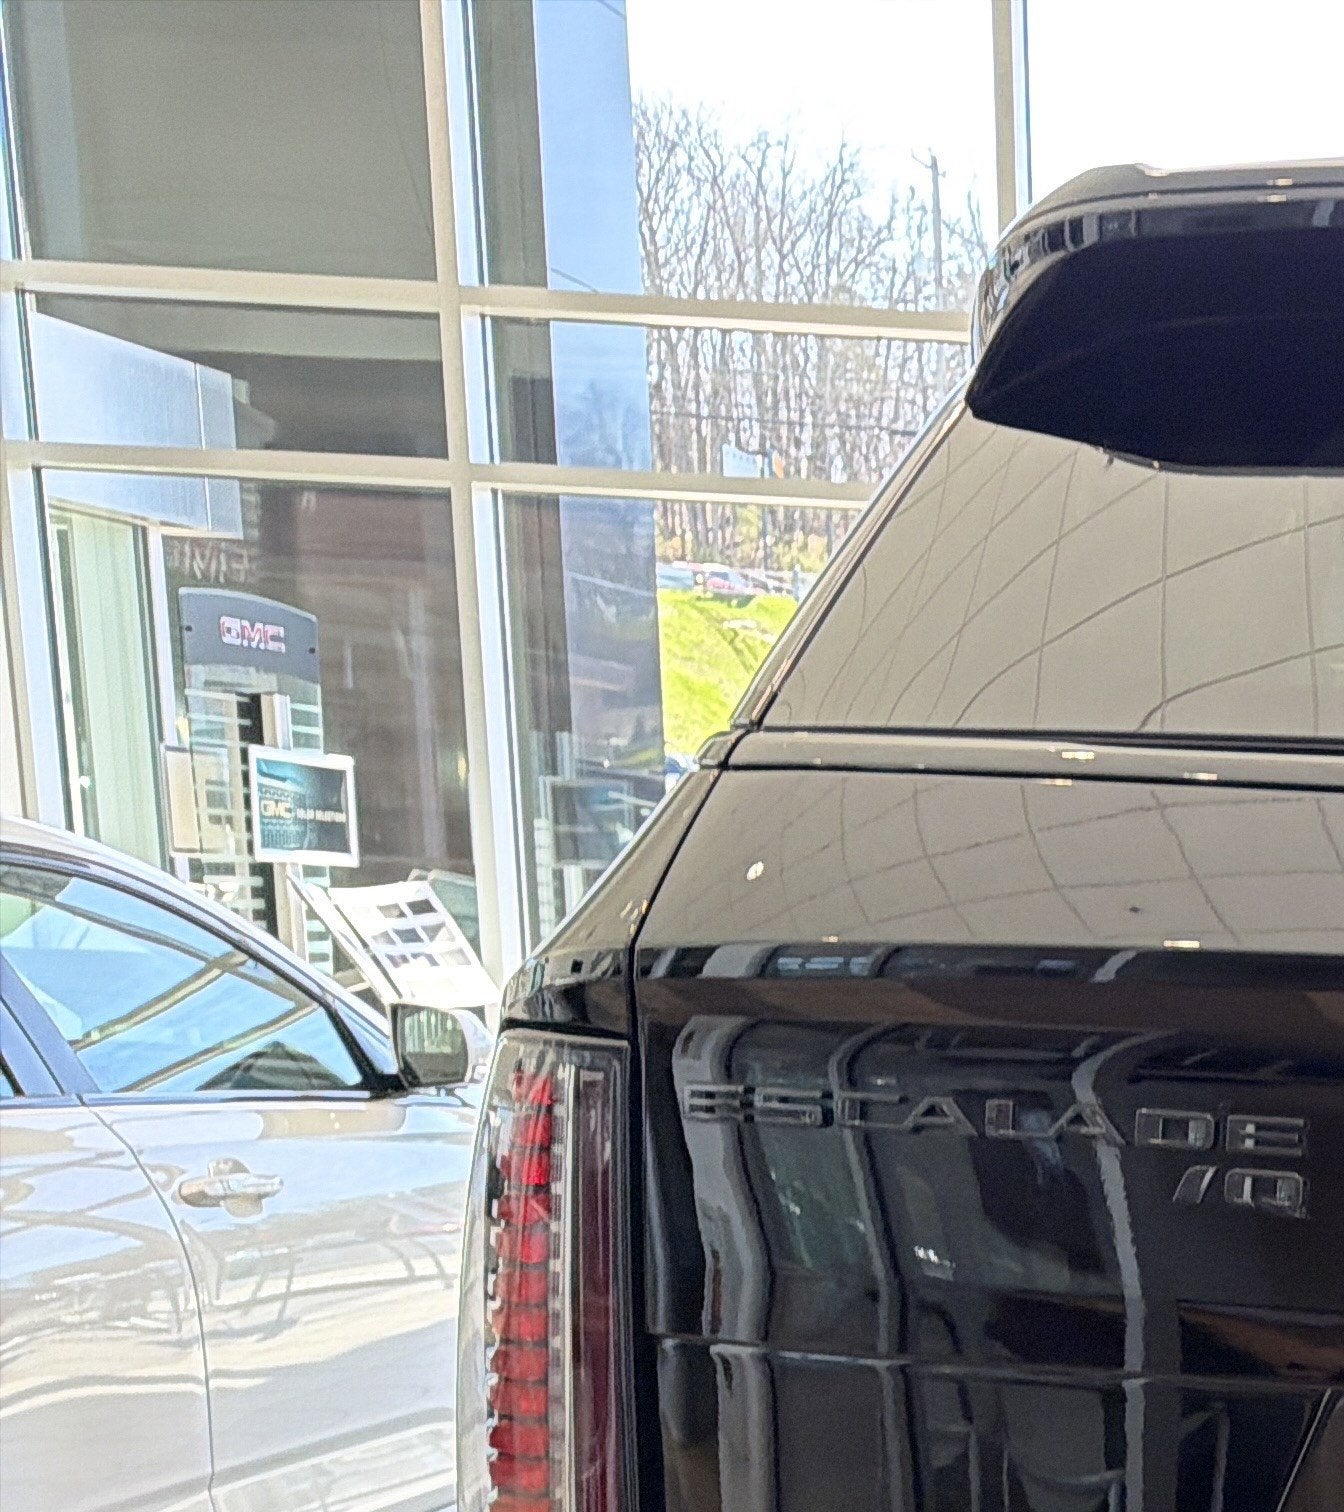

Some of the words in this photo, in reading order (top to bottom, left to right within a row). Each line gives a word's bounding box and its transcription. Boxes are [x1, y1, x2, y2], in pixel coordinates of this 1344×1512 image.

[219, 614, 286, 655] GMC
[260, 799, 293, 819] GMC
[682, 1083, 1308, 1157] ESCALADE
